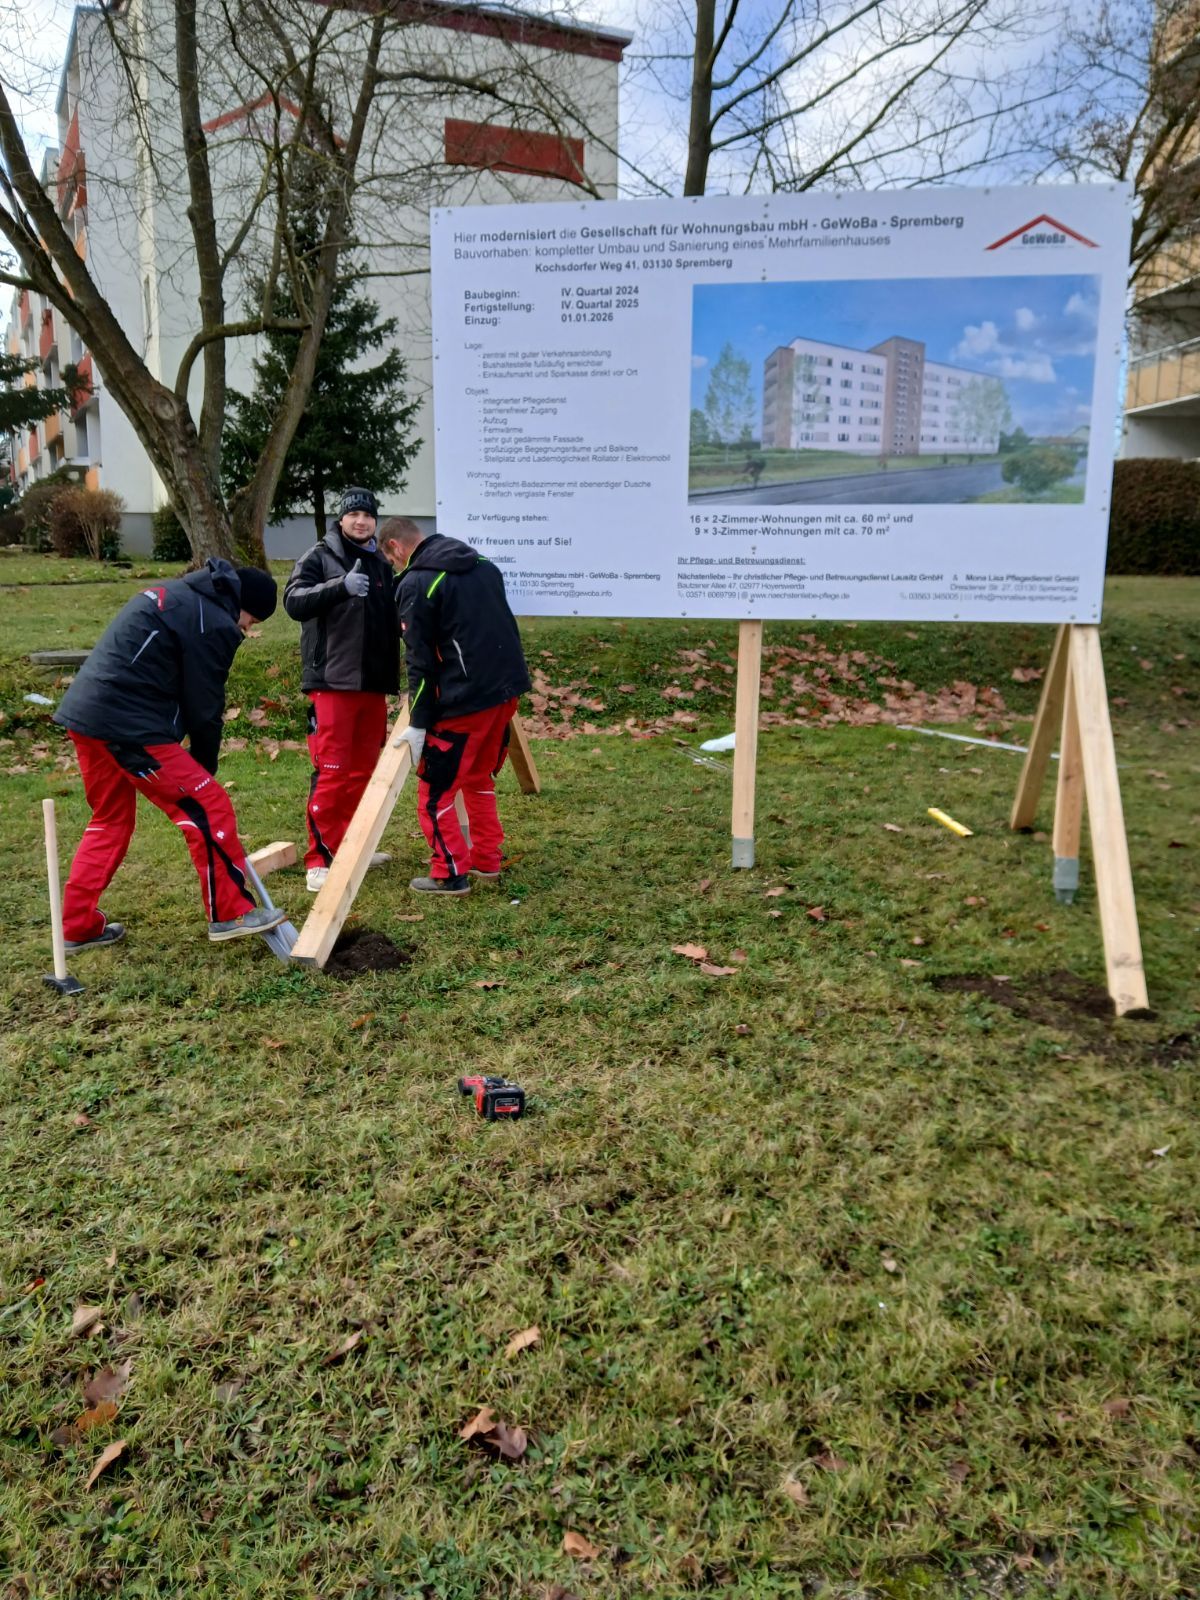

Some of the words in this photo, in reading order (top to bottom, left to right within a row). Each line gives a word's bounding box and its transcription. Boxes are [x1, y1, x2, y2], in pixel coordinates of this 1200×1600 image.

[453, 231, 477, 243] Hier
[479, 228, 557, 242] modernisiert
[558, 228, 577, 239] die
[579, 224, 658, 238] Gesellschaft
[660, 224, 679, 235] für
[681, 220, 775, 234] Wohnungsbau
[777, 219, 808, 231] mbH
[820, 217, 878, 230] GeWoBa
[889, 215, 964, 230] Spremberg
[1022, 233, 1066, 244] GeWoBa
[453, 245, 531, 259] Bauvorhaben:
[534, 244, 596, 258] kompletter
[597, 242, 640, 254] Umbau
[642, 241, 666, 253] und
[667, 238, 729, 254] Sanierung
[731, 237, 767, 250] eines
[767, 233, 891, 248] Mehrfamilienhauses
[534, 261, 598, 272] Kochsdorfer
[598, 260, 623, 272] Weg
[641, 258, 673, 269] 03130
[674, 256, 733, 270] Spremberg
[463, 289, 521, 301] Baubeginn:
[560, 287, 574, 296] IV.
[575, 286, 612, 296] Quartal
[615, 285, 639, 295] 2024
[462, 301, 536, 314] Fertigstellung:
[560, 300, 573, 309] IV.
[575, 299, 612, 309] Quartal
[615, 298, 639, 308] 2025
[463, 315, 503, 326] Einzug:
[559, 312, 616, 322] 01.01.2026
[483, 417, 508, 426] Aufzug
[481, 514, 520, 523] Verfügung
[690, 515, 701, 524] 16
[712, 514, 822, 526] 2-Zimmer-Wohnungen
[824, 514, 841, 523] mit
[861, 514, 874, 523] 60
[893, 514, 913, 523] und
[694, 526, 700, 535] 9
[711, 526, 822, 537] 3-Zimmer-Wohnungen
[824, 526, 840, 535] mit
[860, 526, 873, 535] 70
[468, 537, 484, 546] Wir
[484, 537, 516, 545] freuen
[536, 537, 552, 545] auf
[553, 537, 572, 545] Sie!
